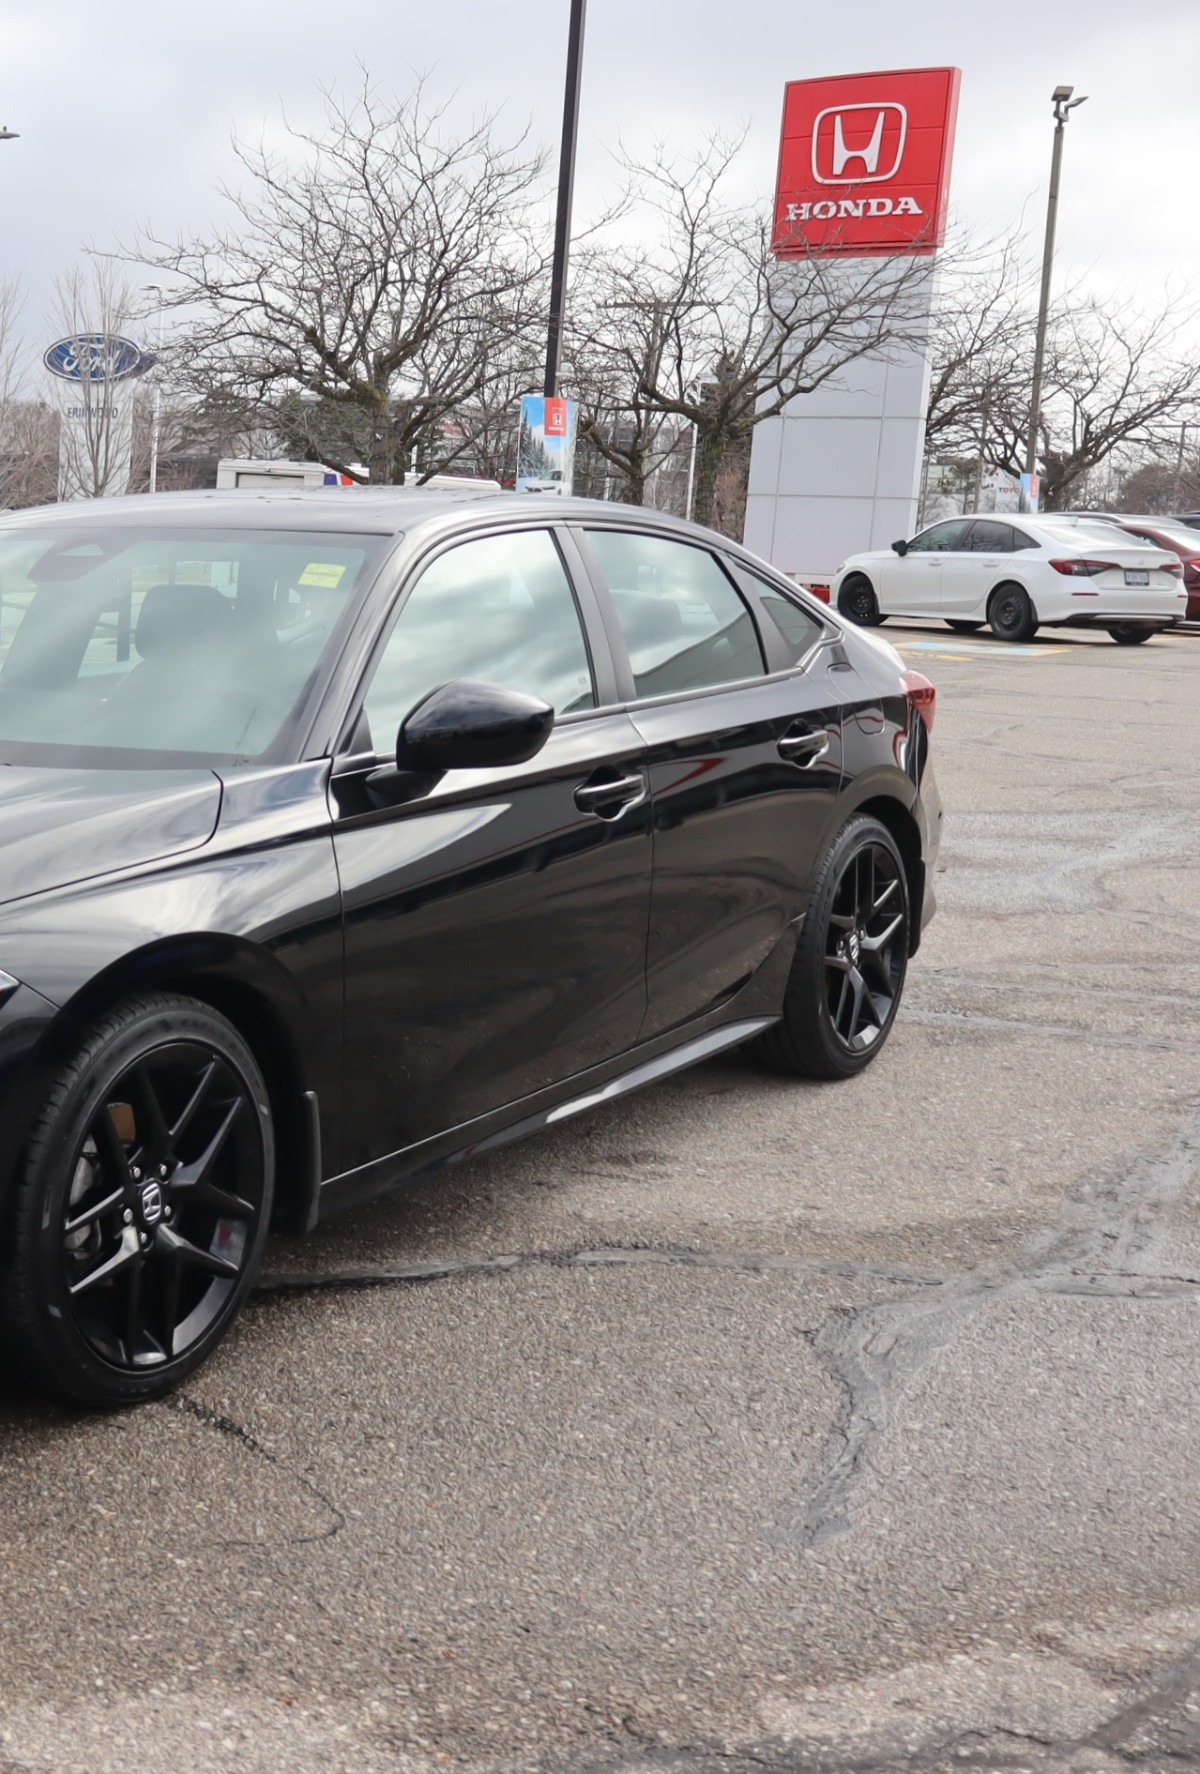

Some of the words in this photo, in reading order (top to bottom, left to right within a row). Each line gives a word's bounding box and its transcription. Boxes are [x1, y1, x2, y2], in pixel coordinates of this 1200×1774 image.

[785, 196, 923, 221] HONDA
[67, 407, 119, 419] ERINWOD
[998, 486, 1021, 494] TOYO
